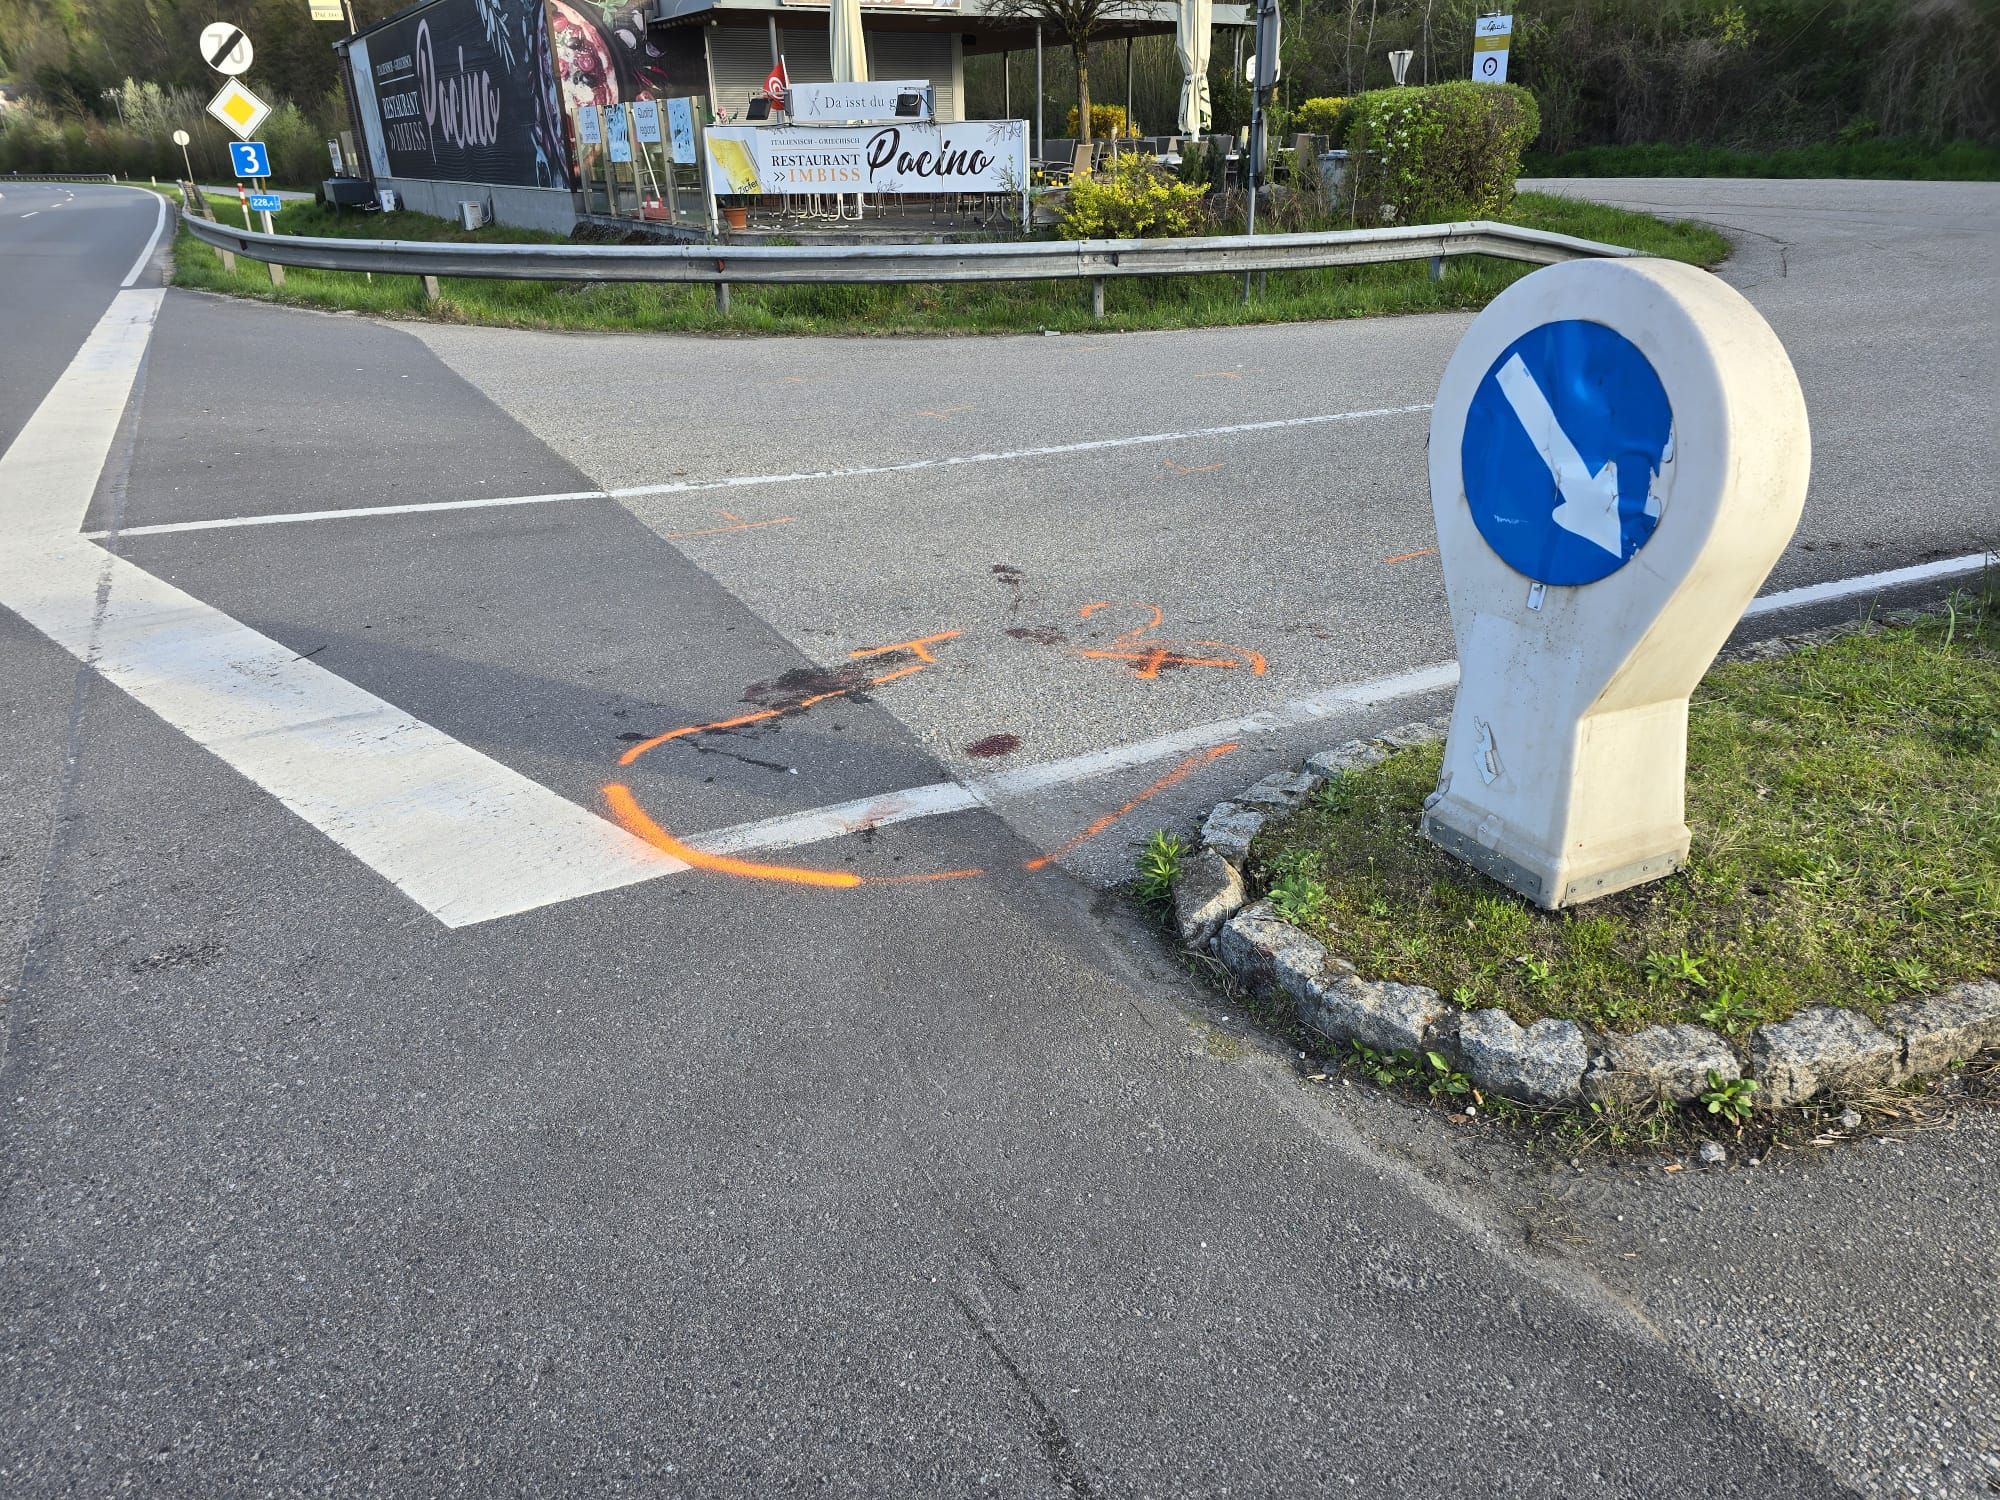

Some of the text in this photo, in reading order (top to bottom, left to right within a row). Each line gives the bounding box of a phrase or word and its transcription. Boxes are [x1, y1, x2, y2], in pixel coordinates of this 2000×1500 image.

[416, 18, 500, 166] Pacino
[825, 96, 841, 109] Da
[845, 95, 865, 108] isst
[870, 94, 884, 108] du
[239, 145, 260, 174] 3
[771, 153, 861, 168] RESTAURANT
[866, 127, 996, 185] Pacino
[789, 168, 862, 184] IMBISS
